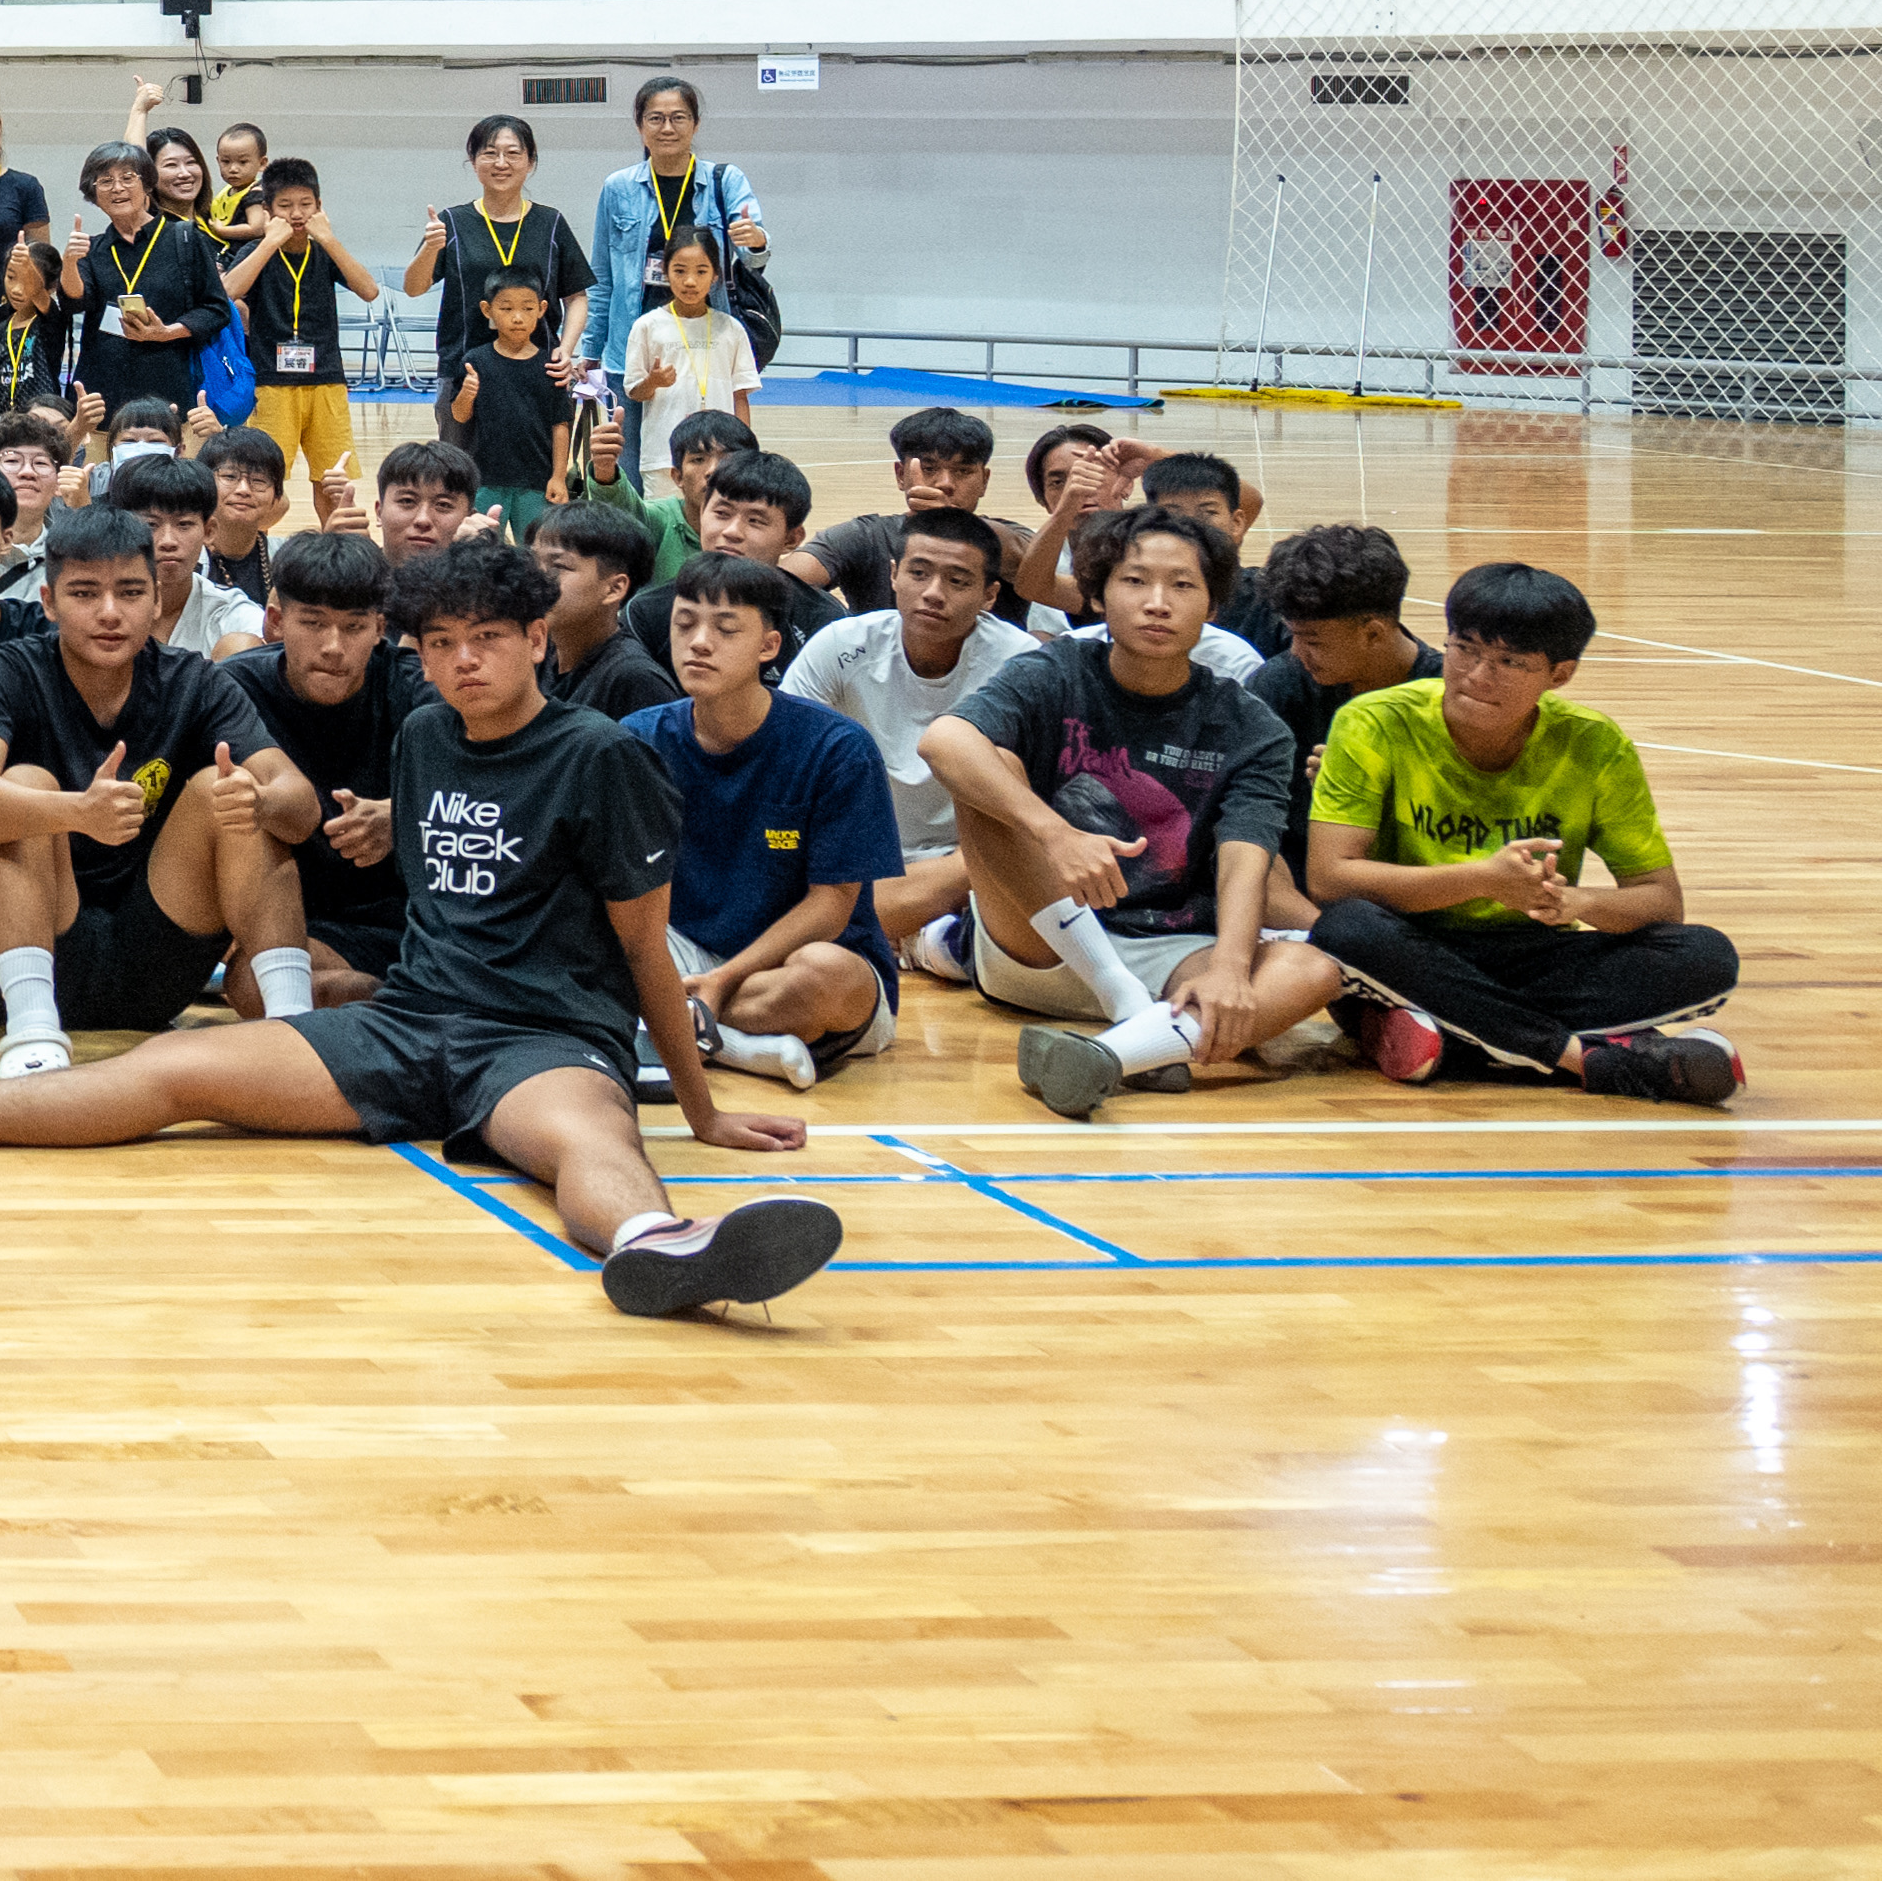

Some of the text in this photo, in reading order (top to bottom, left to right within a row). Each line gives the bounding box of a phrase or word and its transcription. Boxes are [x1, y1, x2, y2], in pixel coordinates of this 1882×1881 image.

[427, 790, 501, 827] Nike
[418, 821, 523, 862] Track
[425, 857, 496, 896] Club
